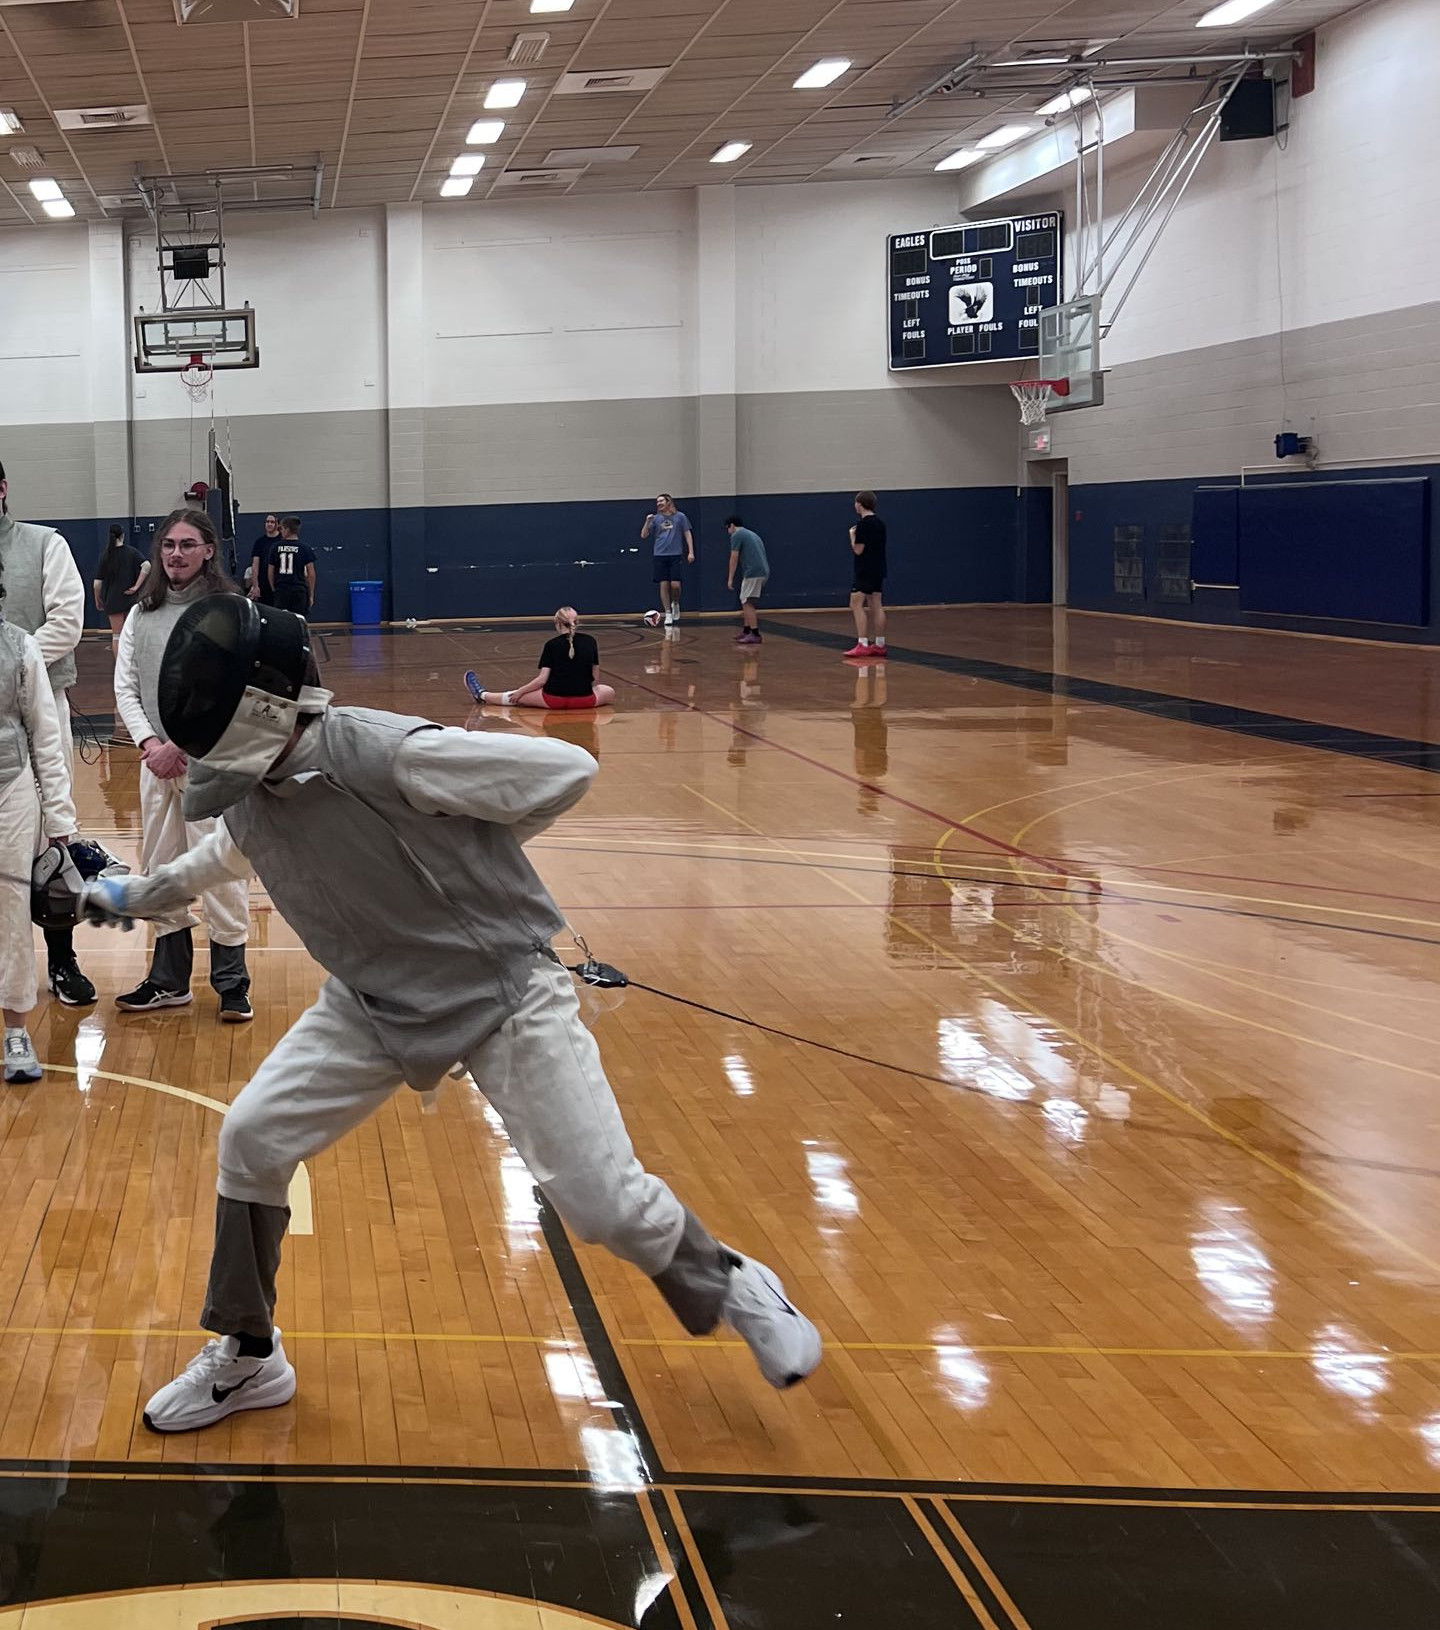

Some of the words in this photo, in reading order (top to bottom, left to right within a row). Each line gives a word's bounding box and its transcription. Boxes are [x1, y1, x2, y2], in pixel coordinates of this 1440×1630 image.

[1014, 217, 1056, 232] VISITOR
[895, 235, 925, 248] EAGLES
[950, 264, 977, 275] PERIOD
[1012, 262, 1039, 273] BONUS
[906, 276, 930, 286] BONUS
[1013, 275, 1053, 287] TIMEOUTS
[894, 290, 930, 301] TIMEOUTS
[1024, 305, 1043, 315] LEFT
[903, 318, 920, 328] LEFT
[947, 325, 973, 335] PLAYER
[979, 322, 1003, 332] FOULS
[1018, 319, 1038, 328] FOUL
[902, 330, 925, 340] FOULS
[279, 553, 293, 574] 11
